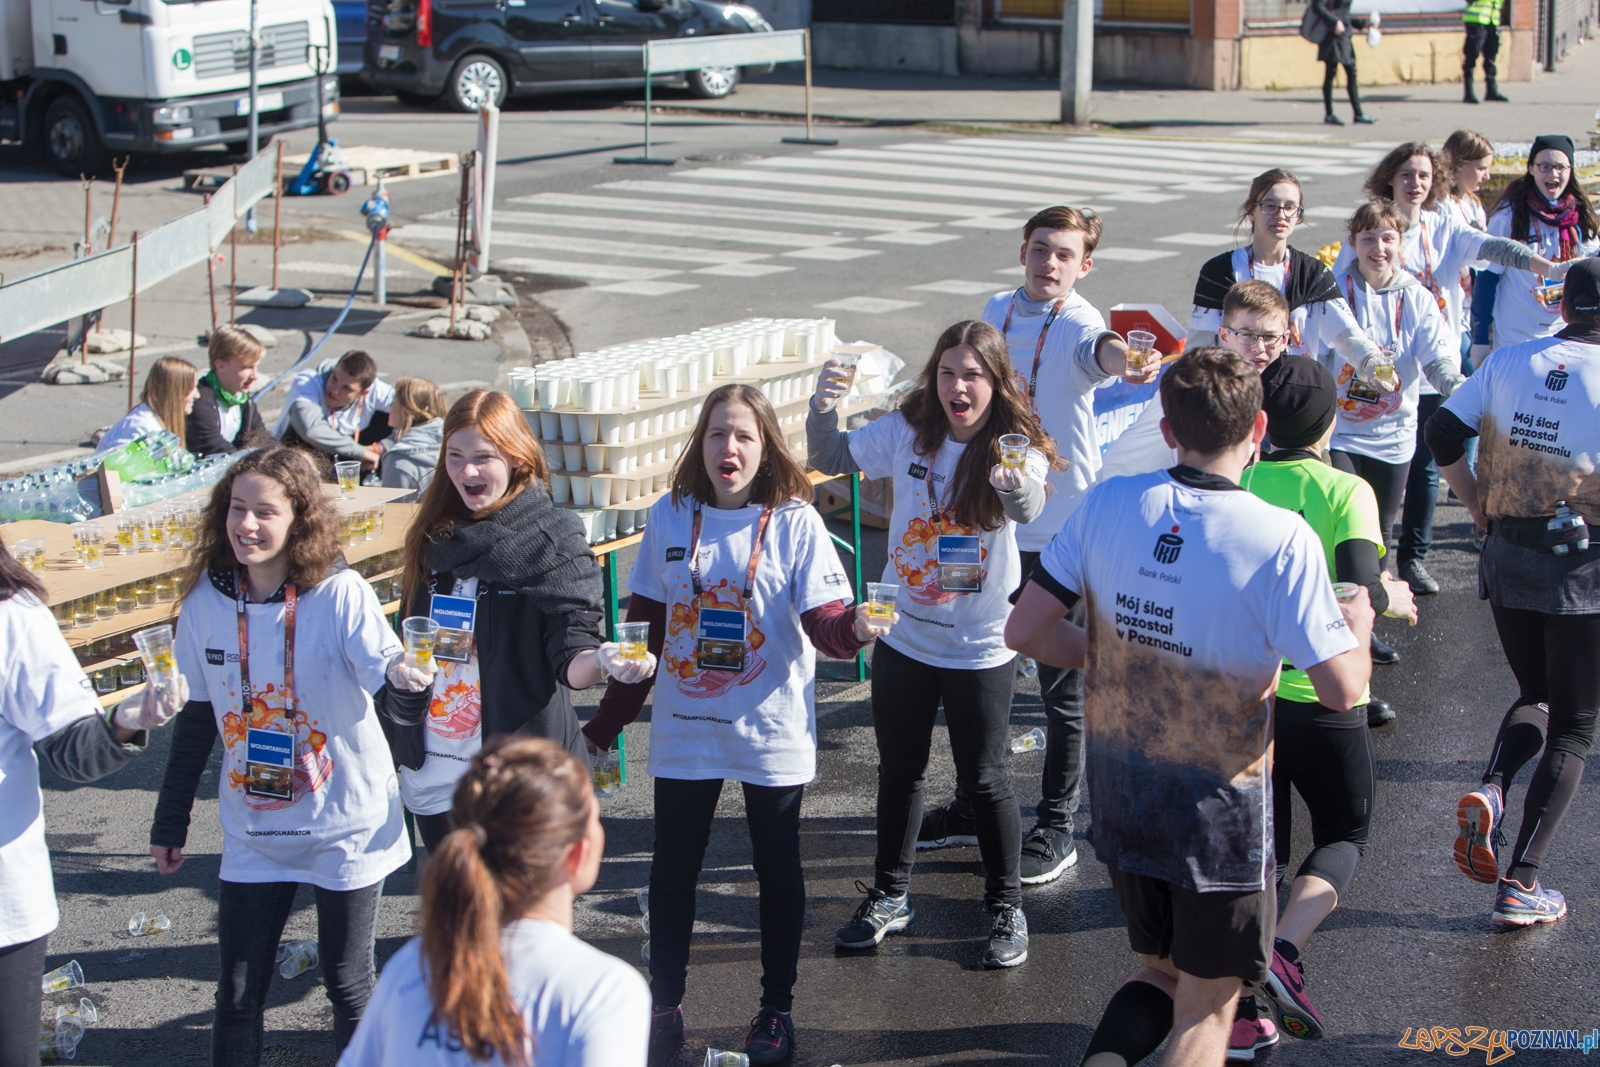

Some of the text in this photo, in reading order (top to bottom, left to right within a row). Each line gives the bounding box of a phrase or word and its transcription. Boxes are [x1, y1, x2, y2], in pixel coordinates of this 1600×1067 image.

[1533, 392, 1568, 405] Bank Polski
[1513, 411, 1560, 431] Mój ślad
[1510, 426, 1559, 442] pozostał
[1509, 437, 1572, 458] w Poznaniu
[1138, 566, 1182, 585] Bank Polski
[433, 608, 472, 619] WOLONTARIUSZ
[1115, 592, 1174, 620] Mój ślad
[702, 621, 743, 629] WOLONTARIUSZ
[1115, 611, 1174, 636] pozostał
[1116, 627, 1193, 658] w Poznaniu
[249, 742, 291, 754] WOLONTARIUSZ
